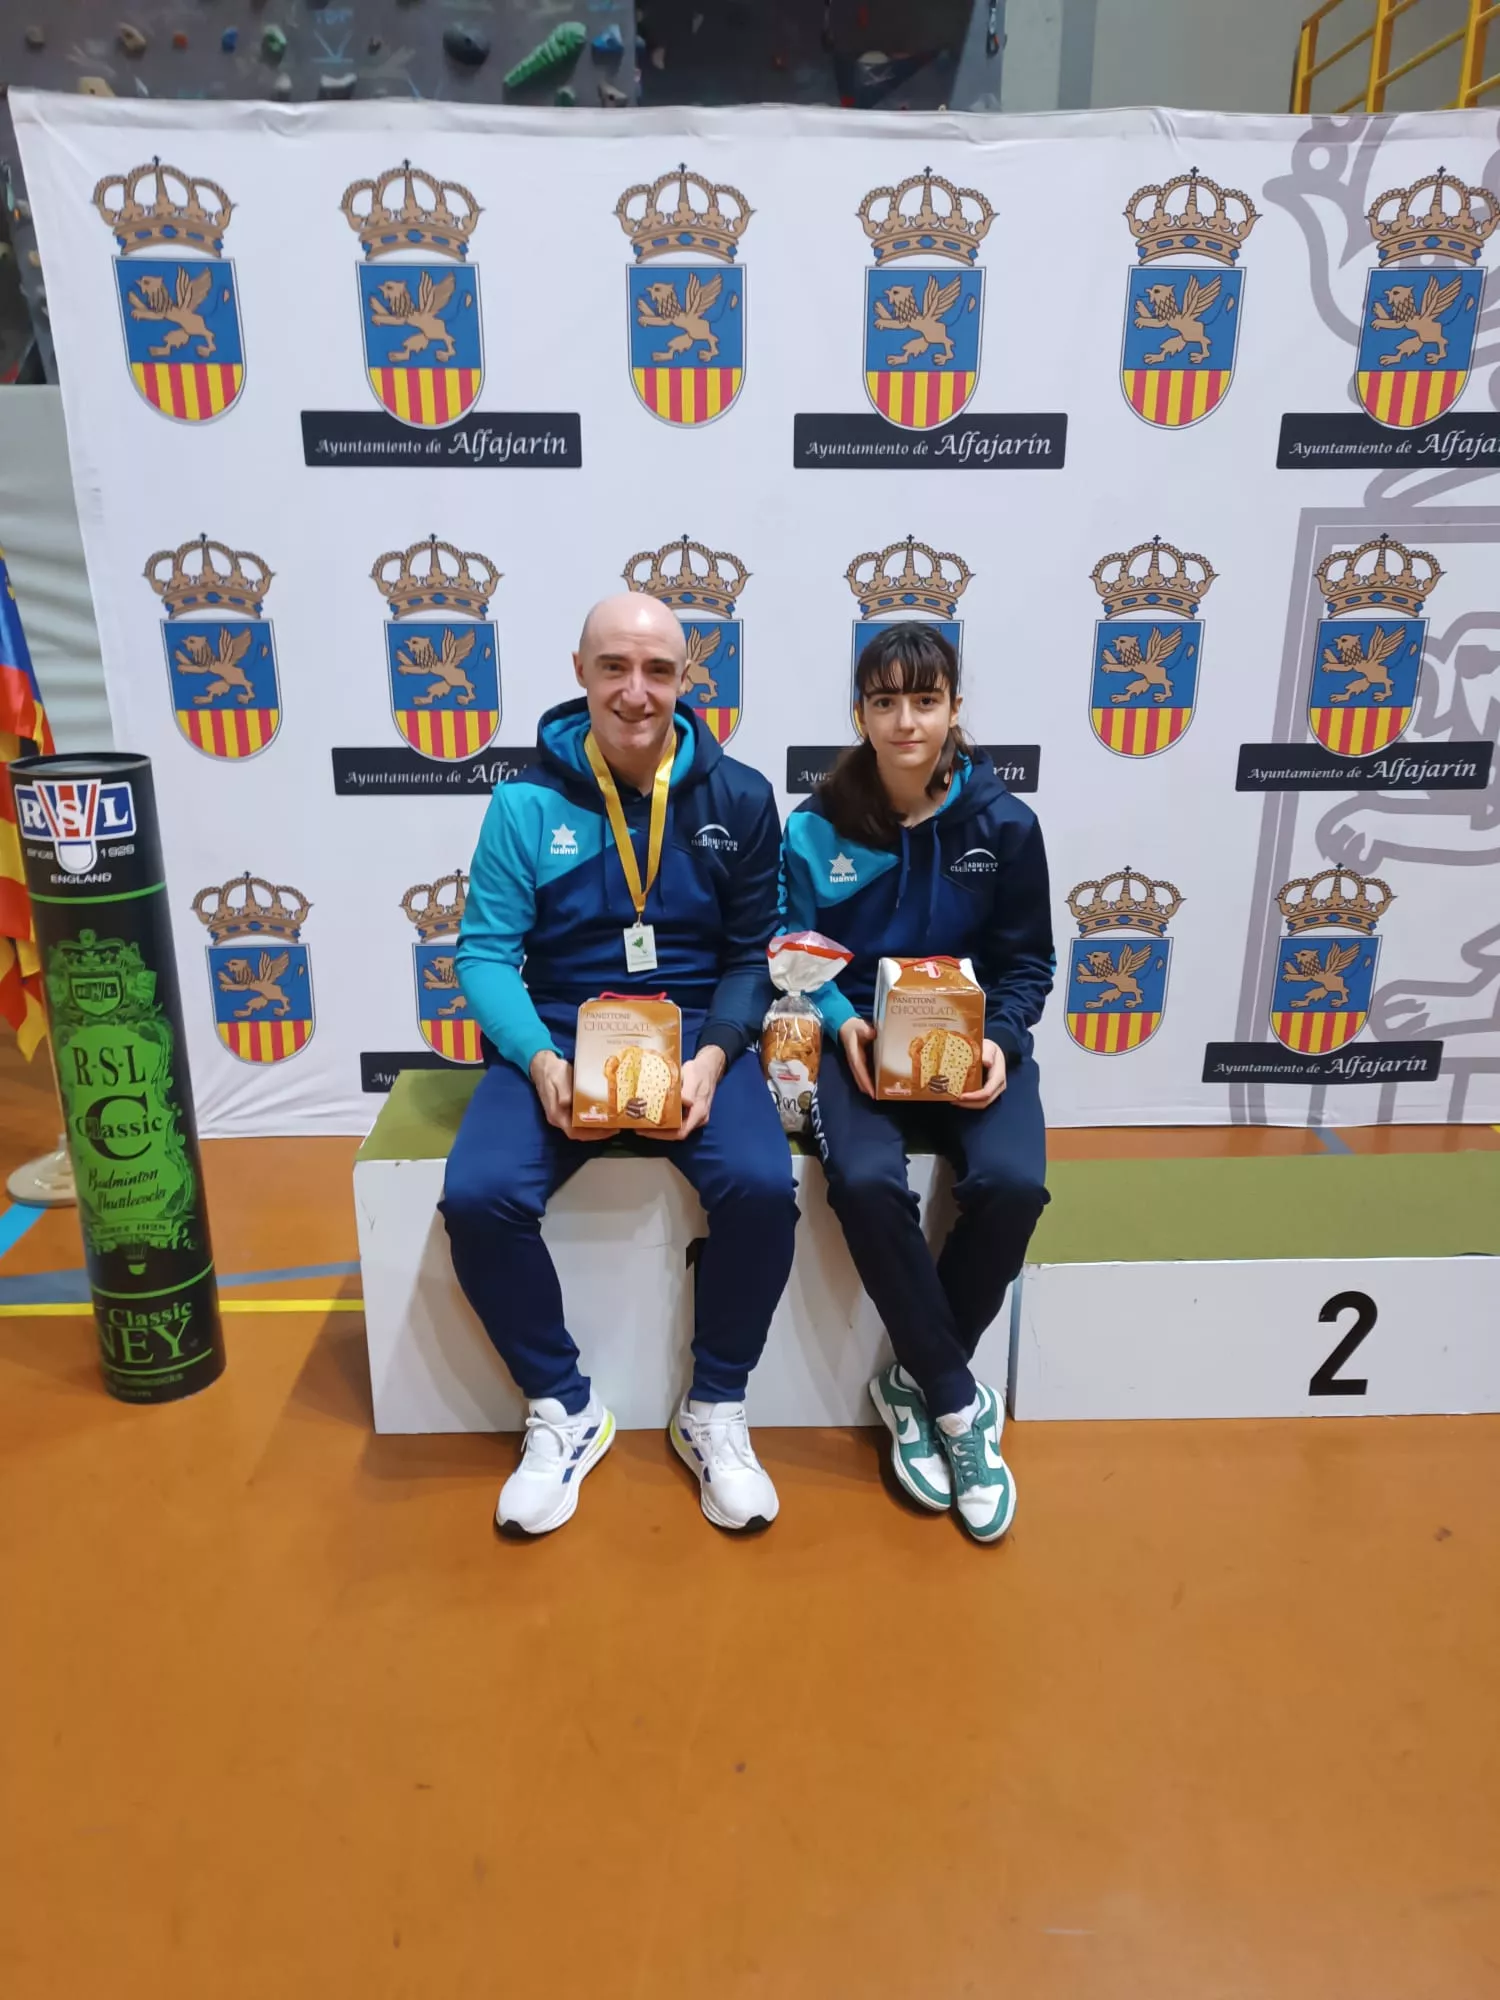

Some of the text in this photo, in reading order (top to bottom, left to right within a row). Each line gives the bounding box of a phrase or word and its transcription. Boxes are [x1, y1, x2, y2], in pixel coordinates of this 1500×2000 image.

[316, 428, 568, 462] Ayuntamiento de Alfajarín
[805, 431, 1051, 462] Ayuntamiento de Alfajarín
[1289, 430, 1500, 461] Ayuntamiento de Alfaja
[345, 771, 443, 787] Ayuntamiento
[446, 769, 462, 783] de
[1248, 757, 1477, 784] Ayuntamiento de Alfajarín
[50, 872, 112, 884] ENGLAND
[1213, 1055, 1428, 1079] Ayuntamiento de Alfajarín
[88, 1168, 158, 1191] Badminton
[108, 1302, 192, 1326] Classic
[1308, 1291, 1378, 1396] 2
